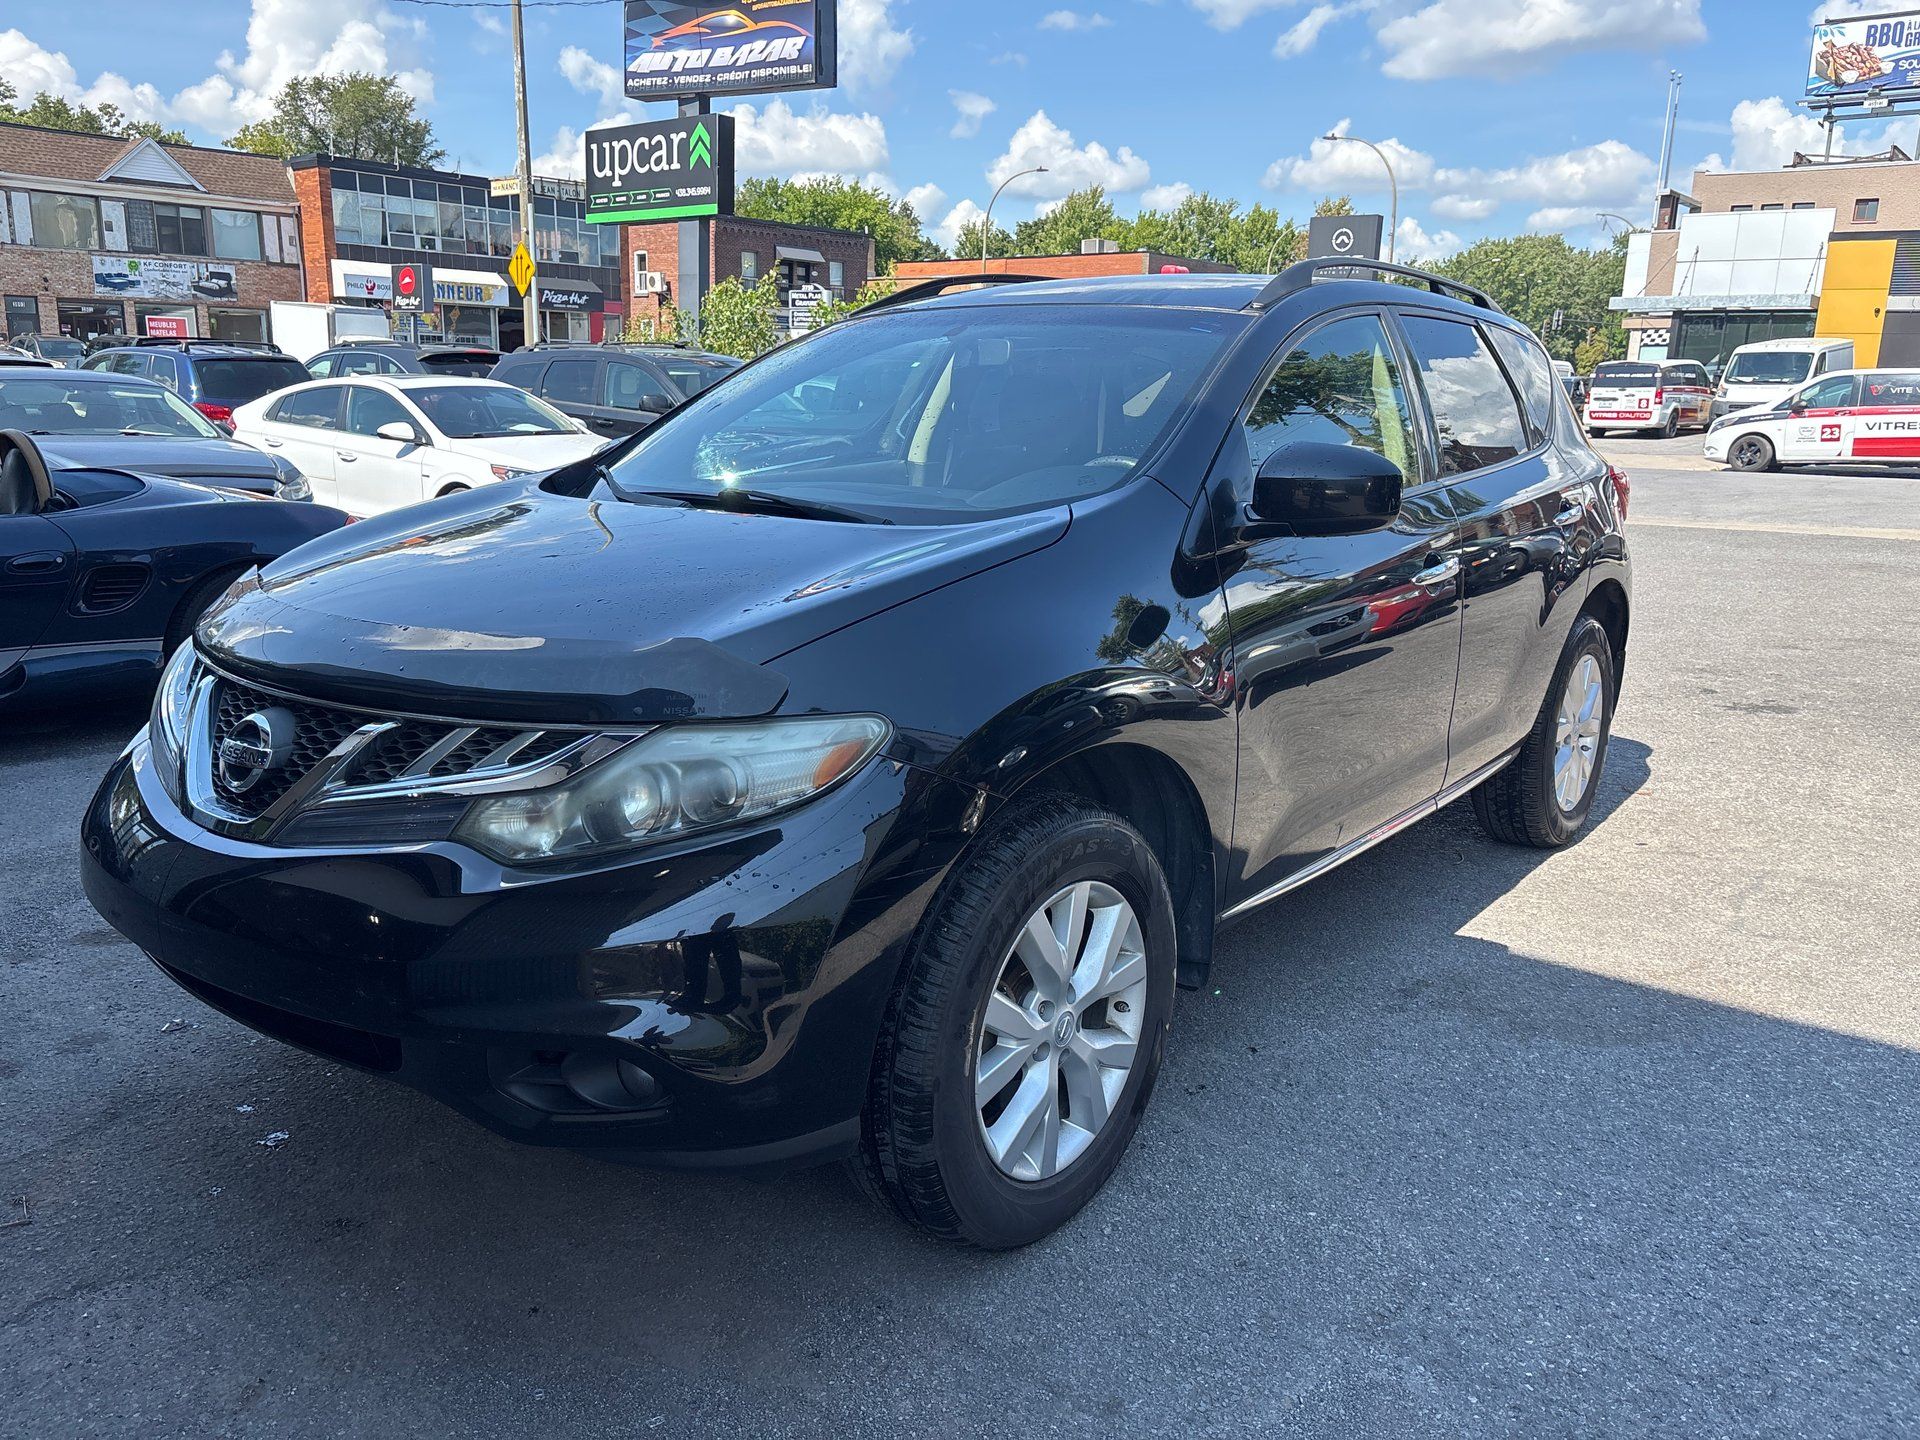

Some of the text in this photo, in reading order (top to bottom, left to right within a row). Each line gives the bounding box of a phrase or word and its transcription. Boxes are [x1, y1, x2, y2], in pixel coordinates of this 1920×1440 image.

[1865, 21, 1905, 47] BBQ
[627, 36, 807, 74] AUTO BAZAR
[627, 63, 812, 87] ACHETEZ VENDEZ CRÉDIT DISPONIBLE!
[590, 131, 687, 187] upcar
[434, 283, 484, 302] NNEUR
[542, 290, 589, 304] Pizza Hut
[1890, 386, 1913, 394] VITE
[1640, 399, 1648, 408] 8
[1822, 427, 1840, 439] 23
[1865, 421, 1920, 431] VITRE
[663, 706, 705, 714] NISSAN
